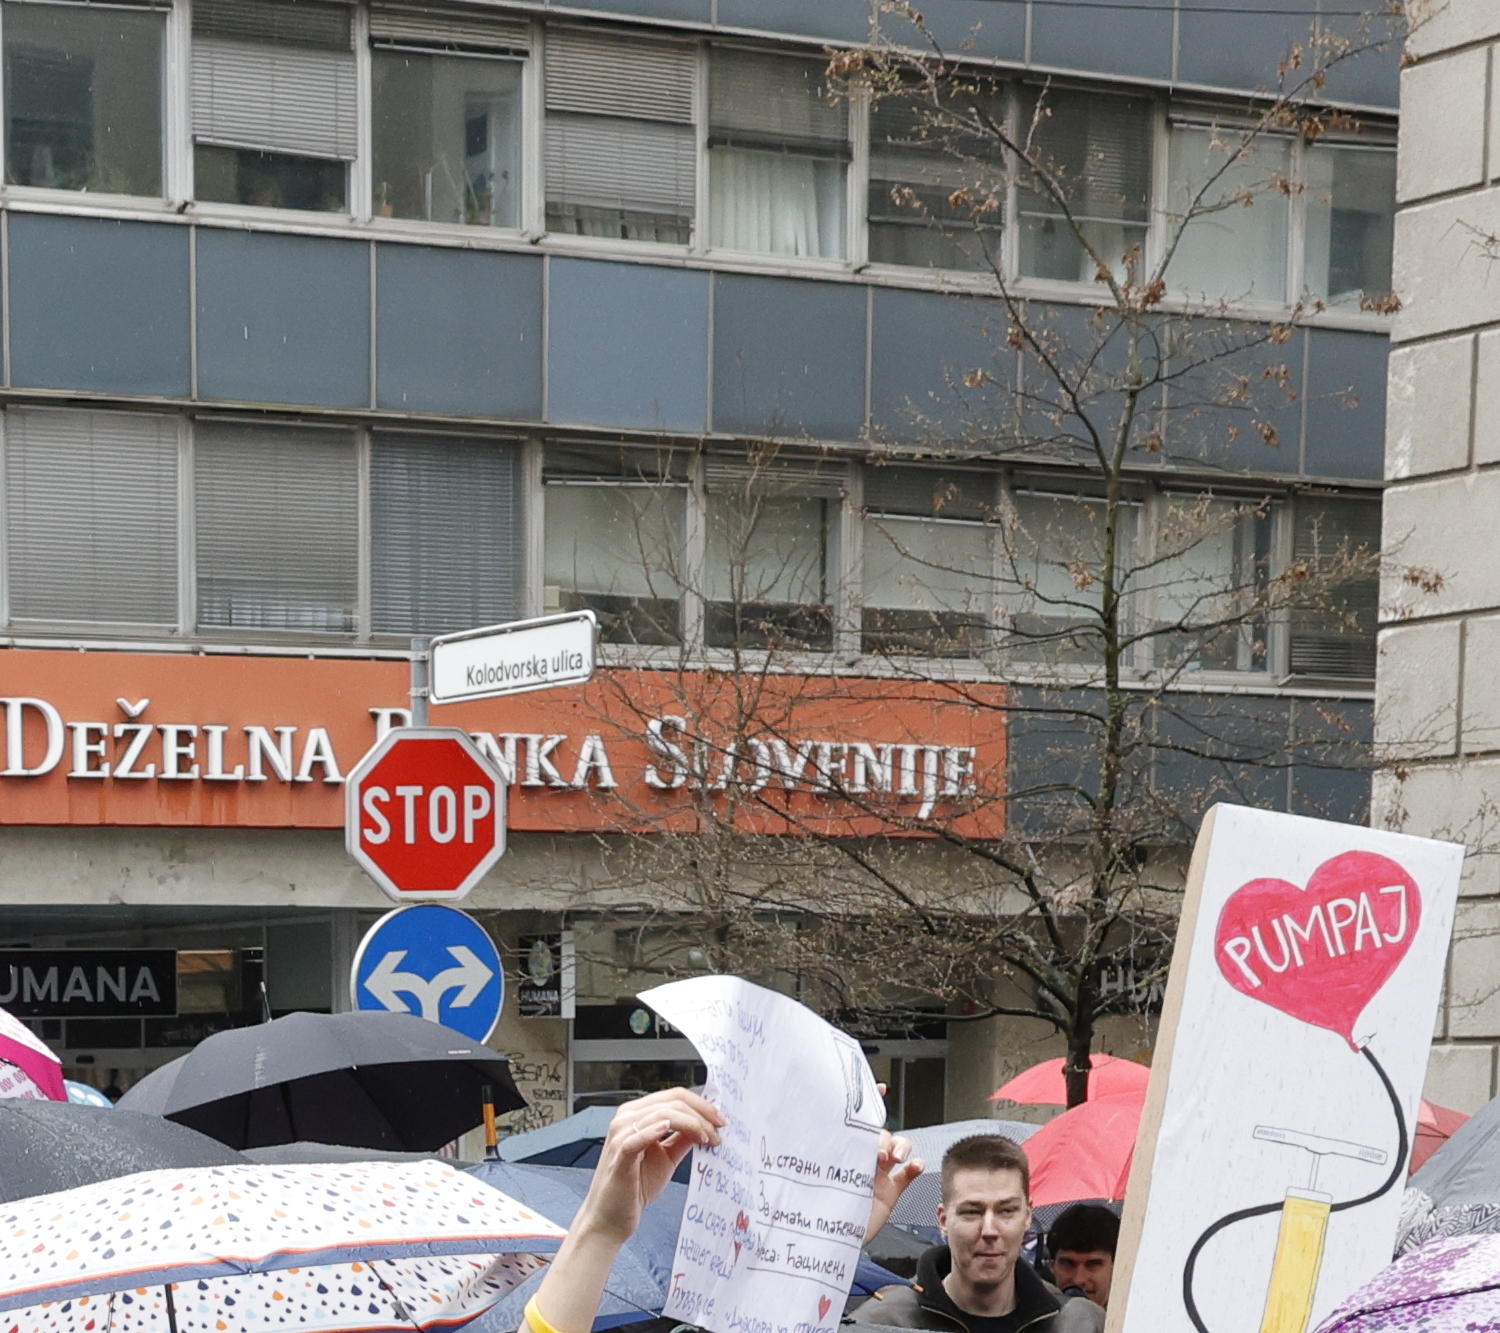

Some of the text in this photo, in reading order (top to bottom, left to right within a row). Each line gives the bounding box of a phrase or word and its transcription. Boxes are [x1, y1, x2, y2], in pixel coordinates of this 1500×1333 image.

[466, 652, 584, 687] Kolodvorska ulica
[368, 707, 619, 788] NKA
[644, 715, 978, 820] SLOVENIJE
[362, 785, 492, 845] STOP
[1223, 885, 1408, 988] PUMPAJ
